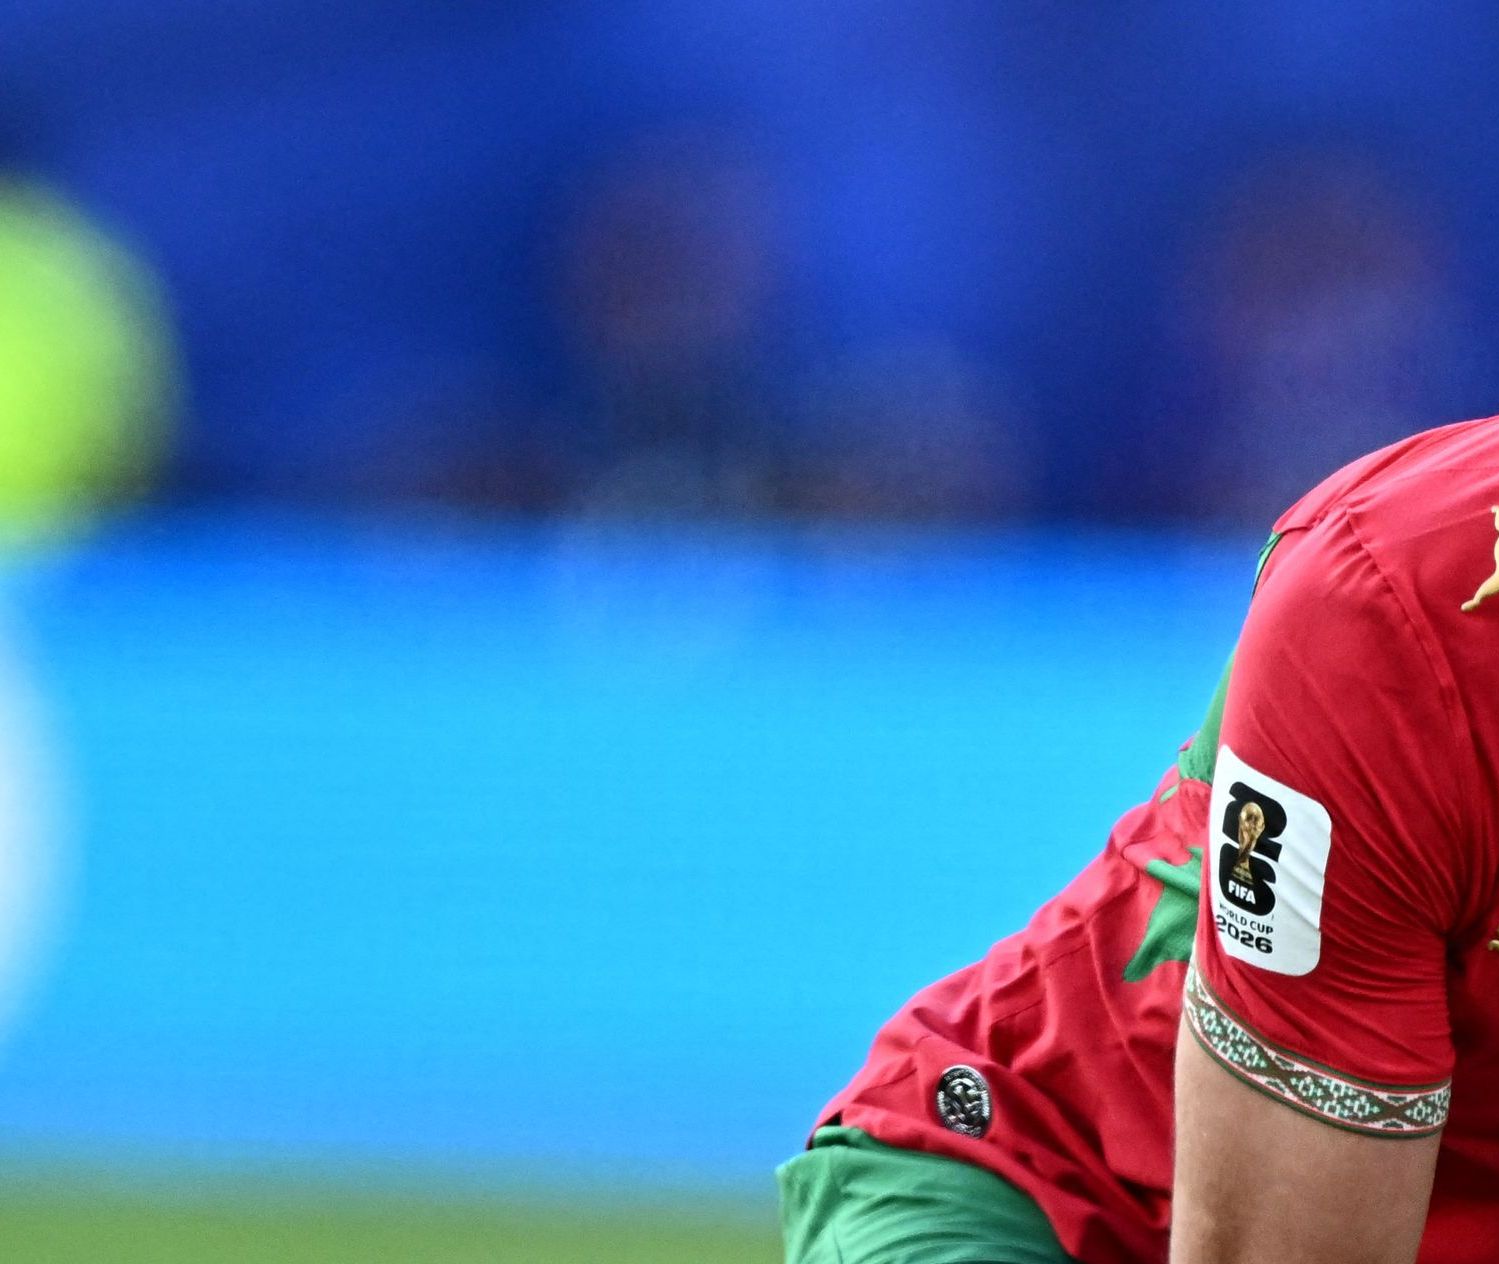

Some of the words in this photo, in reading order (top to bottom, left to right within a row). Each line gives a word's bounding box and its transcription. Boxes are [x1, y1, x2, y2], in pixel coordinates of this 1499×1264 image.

[1228, 880, 1256, 905] FIFA
[1216, 914, 1273, 954] 2026
[1249, 920, 1274, 935] CUP
